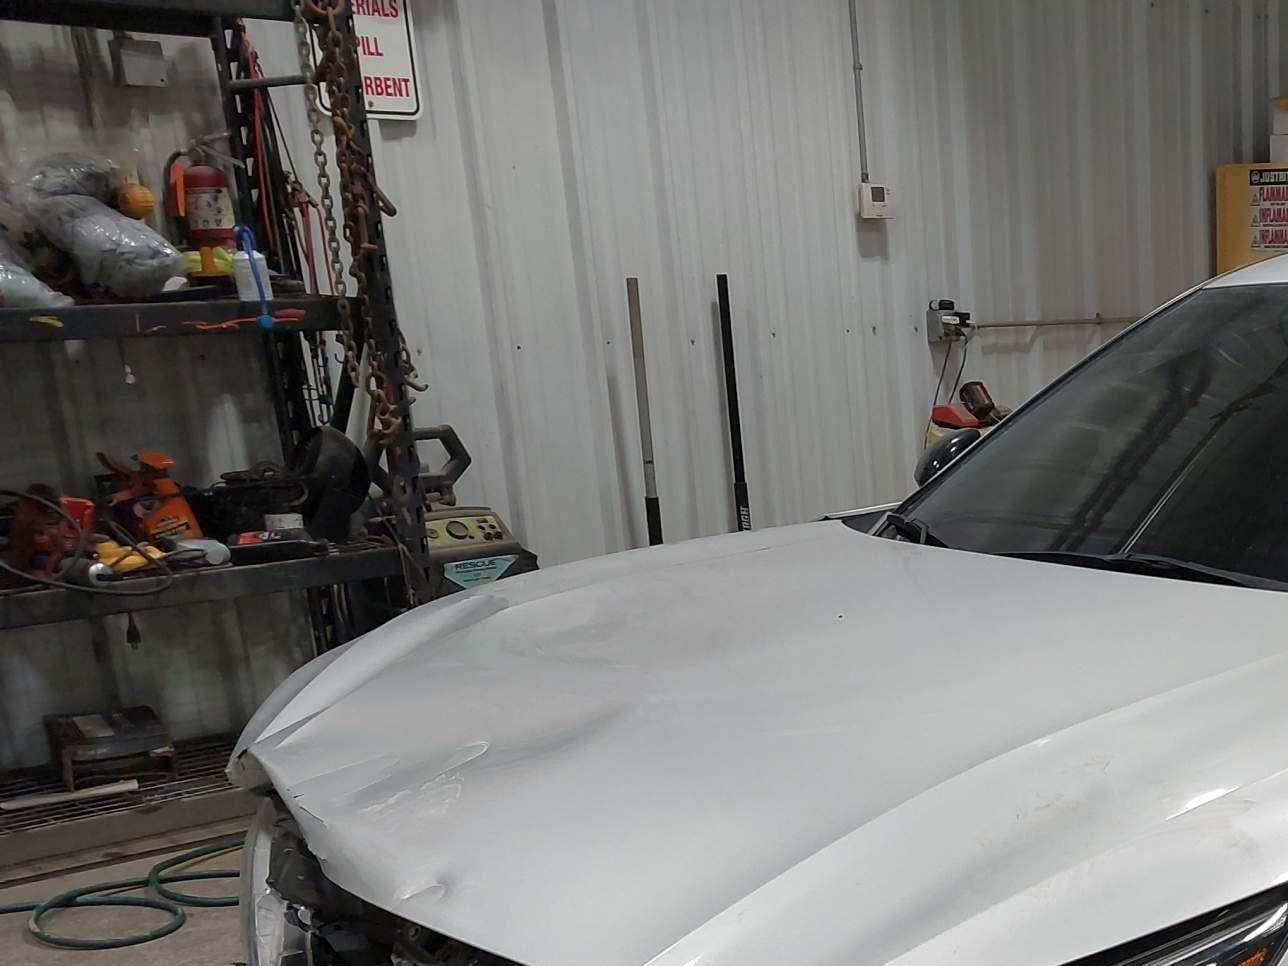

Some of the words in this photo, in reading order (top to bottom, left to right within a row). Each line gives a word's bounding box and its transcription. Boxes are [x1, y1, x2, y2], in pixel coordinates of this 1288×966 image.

[352, 0, 399, 18] RIALS
[353, 36, 383, 56] PILL
[364, 76, 410, 97] RBENT
[455, 559, 496, 570] RESCUE
